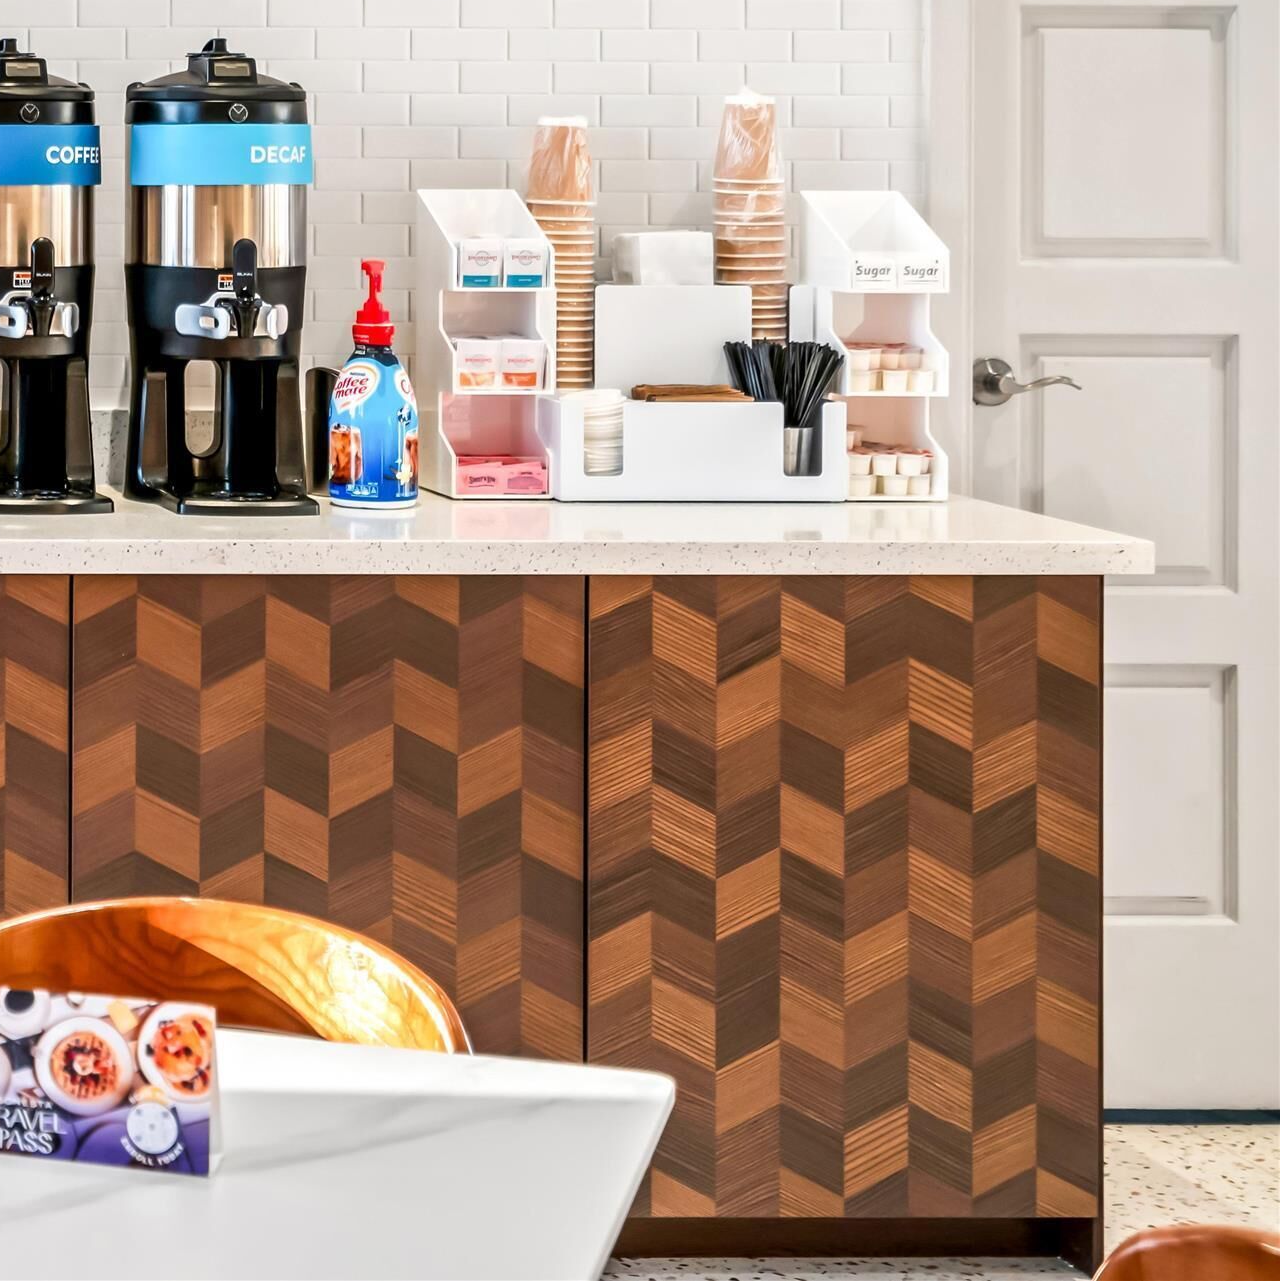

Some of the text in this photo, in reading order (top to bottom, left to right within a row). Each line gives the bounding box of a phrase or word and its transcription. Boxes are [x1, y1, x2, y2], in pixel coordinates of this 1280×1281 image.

[45, 145, 100, 164] COFFEE
[250, 145, 306, 164] DECAF
[855, 265, 891, 278] Sugar
[903, 265, 938, 279] Sugar
[335, 385, 368, 400] mate
